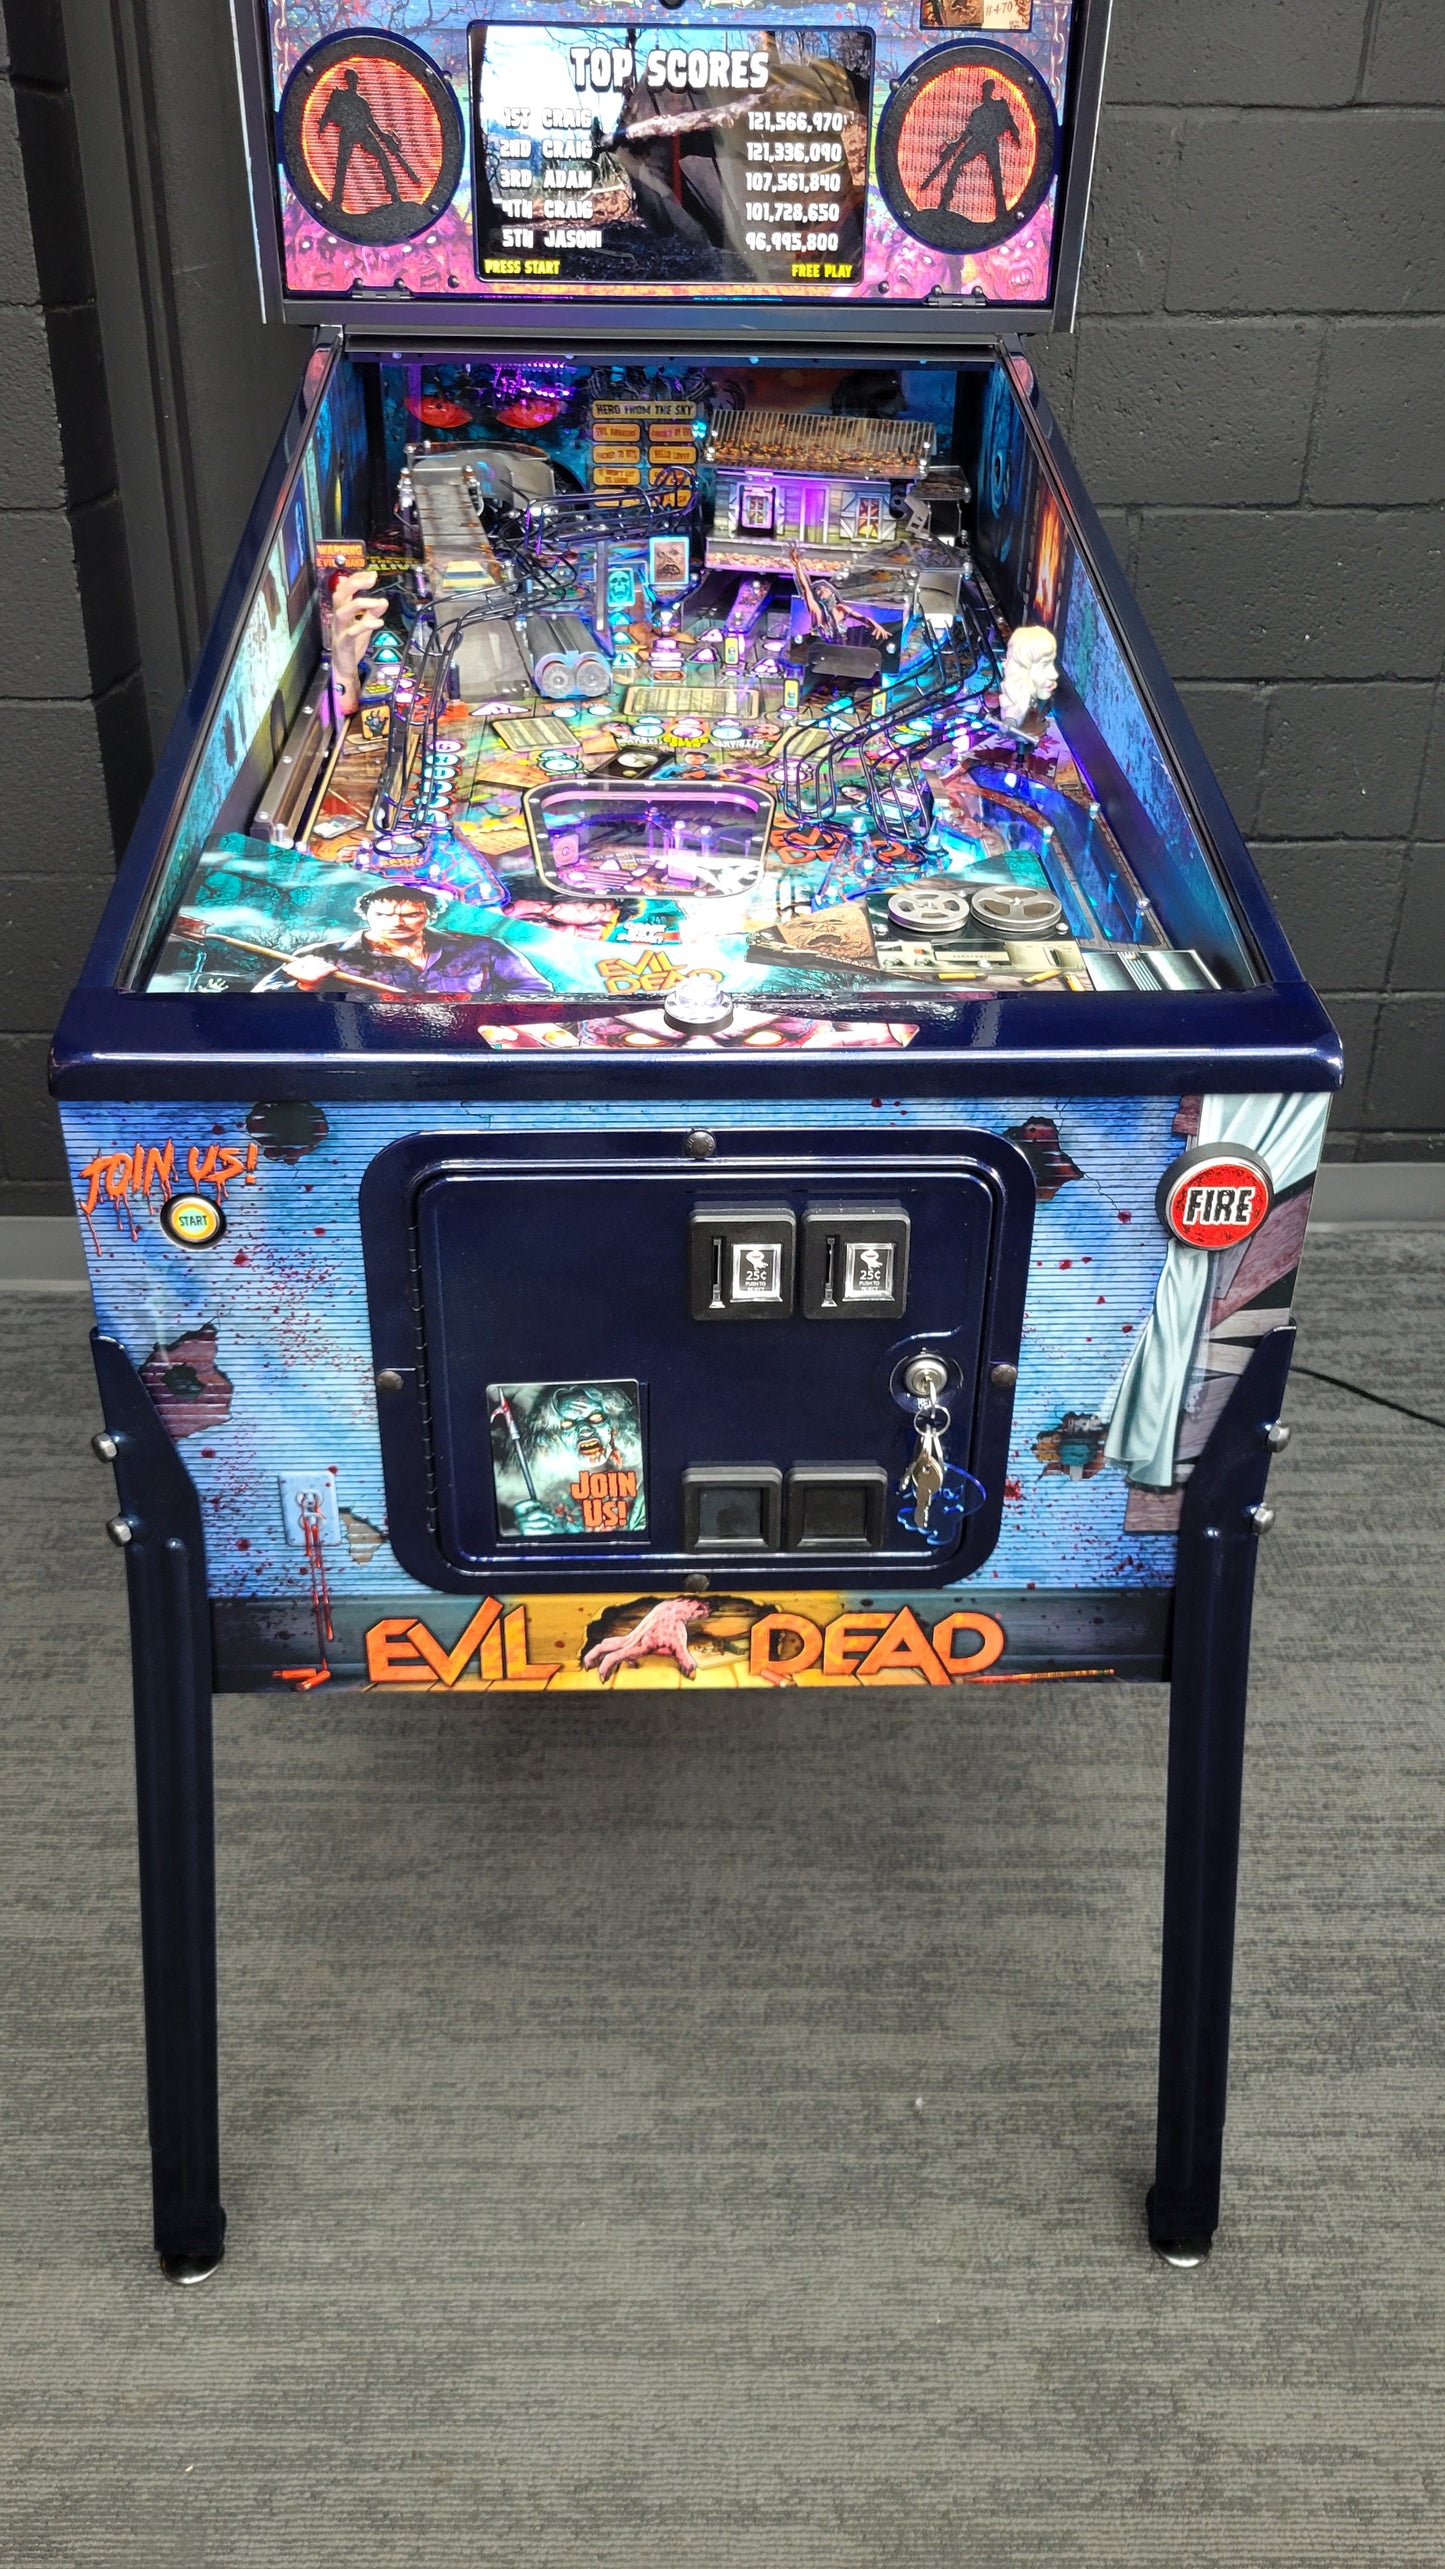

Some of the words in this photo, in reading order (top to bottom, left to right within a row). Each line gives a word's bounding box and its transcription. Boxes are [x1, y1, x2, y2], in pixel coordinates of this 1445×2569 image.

[570, 47, 633, 90] TOP
[647, 49, 769, 91] SCORES
[504, 108, 530, 128] 1ST
[543, 108, 592, 129] CRAIG
[748, 112, 843, 132] 121,566,970
[500, 139, 531, 158] 2ND
[543, 139, 593, 159] CRAIG
[747, 142, 842, 163] 121,336,090
[500, 169, 532, 187] 3RD
[543, 169, 593, 189] ADAM
[746, 172, 841, 193] 107,561,840
[502, 199, 533, 219] 4TH
[544, 199, 593, 219] CRAIG
[746, 202, 839, 223] 101,728,650
[503, 229, 534, 248] 5TH
[746, 232, 838, 252] 96,995,800
[485, 259, 521, 274] PRESS
[525, 260, 560, 275] START
[792, 264, 820, 278] FREE
[824, 264, 853, 278] PLAY
[596, 404, 620, 414] HERO
[625, 405, 650, 415] FROM
[655, 405, 672, 415] THE
[675, 405, 693, 416] SKY
[597, 950, 688, 977] EVIL
[79, 1137, 178, 1225] JOIN
[187, 1143, 259, 1188] US!
[1184, 1187, 1255, 1224] FIRE
[179, 1216, 208, 1226] START
[746, 1271, 767, 1280] 25¢
[860, 1270, 881, 1280] 25¢
[570, 1470, 637, 1500] JOIN
[583, 1499, 627, 1528] US!
[365, 1595, 561, 1687] EVIL
[749, 1606, 1005, 1686] DEAD
